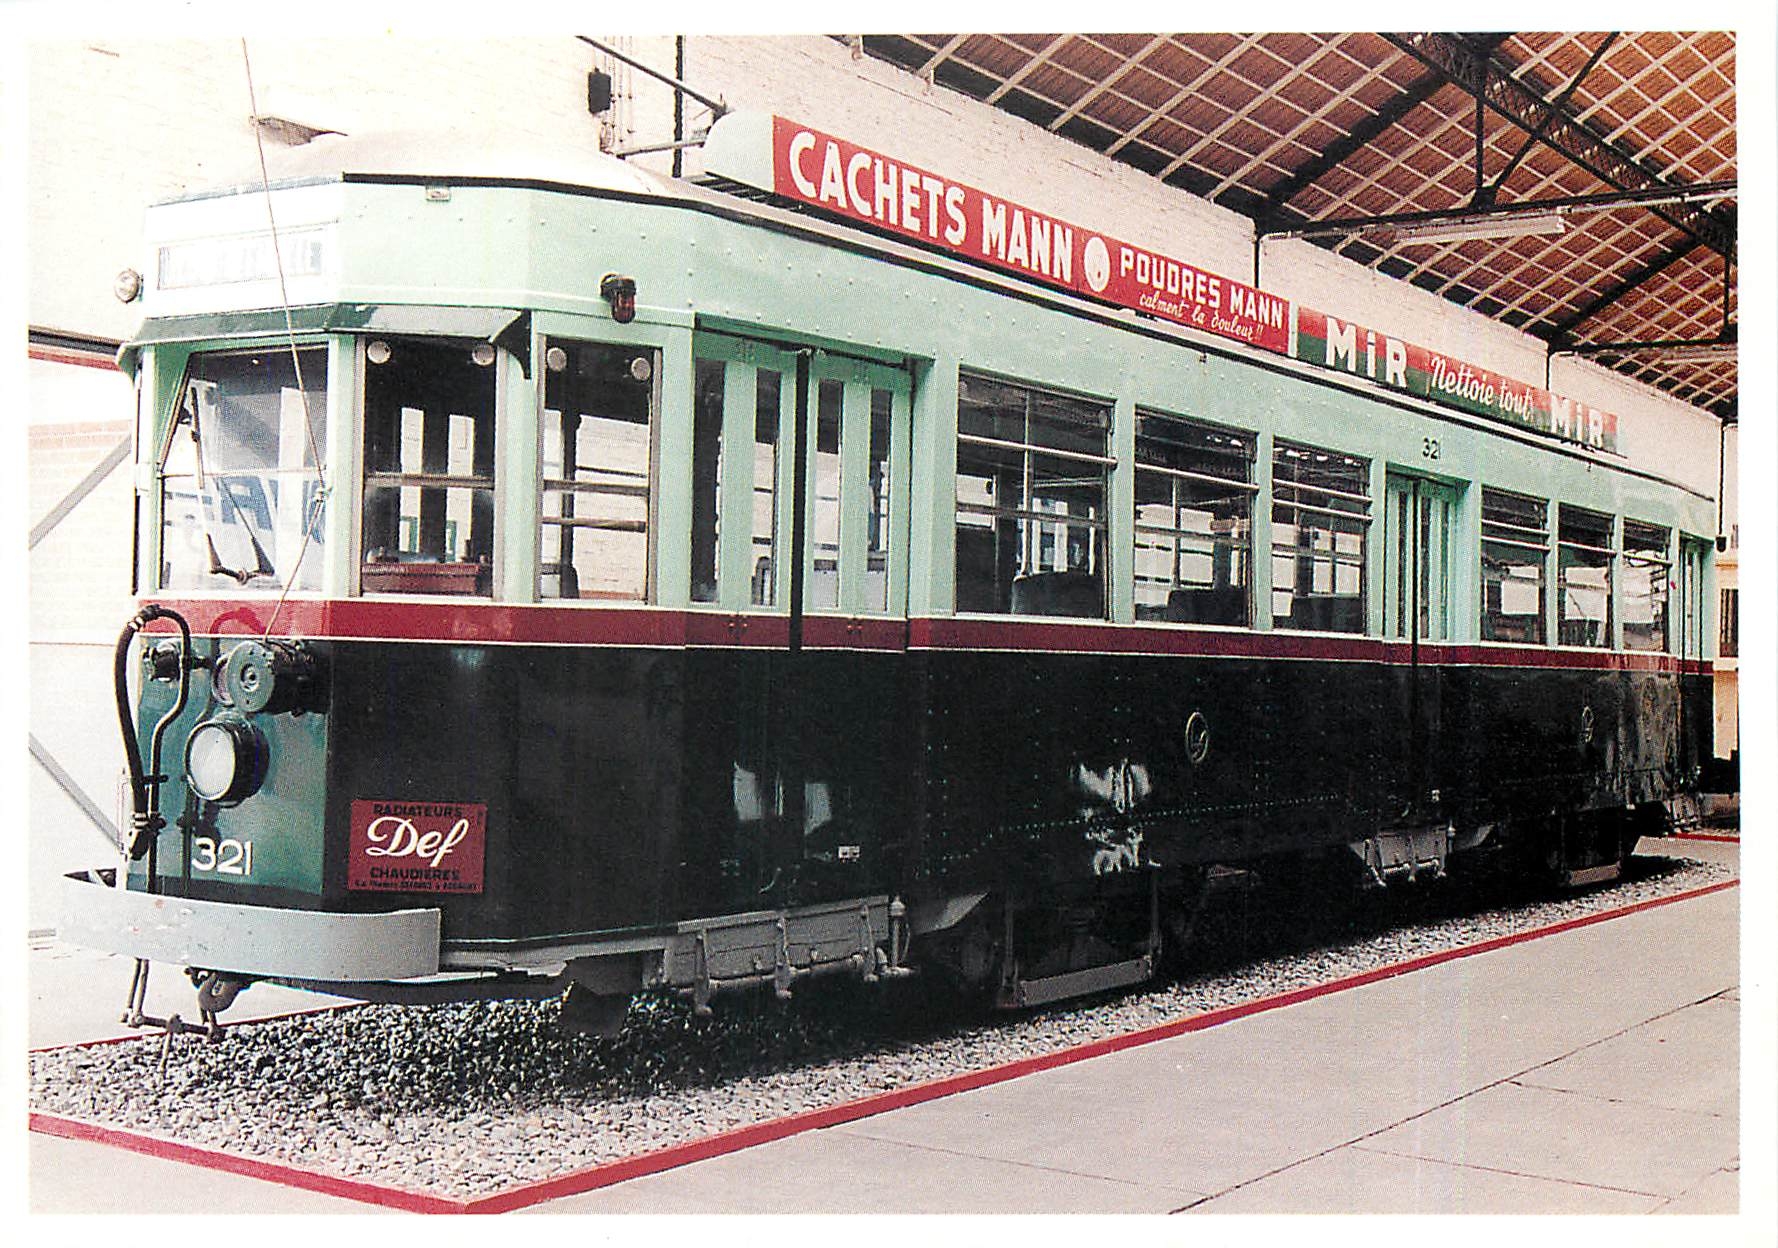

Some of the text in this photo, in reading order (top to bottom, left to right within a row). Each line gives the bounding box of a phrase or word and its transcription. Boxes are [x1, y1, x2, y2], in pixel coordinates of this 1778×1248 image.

[789, 132, 1073, 284] CACHETS MANN
[1120, 247, 1284, 330] POUDRES MANN
[1138, 291, 1190, 319] calment
[1191, 303, 1206, 326] la
[1431, 356, 1495, 407] Nettoie
[372, 803, 464, 818] RADIATEURS
[191, 837, 253, 876] 321
[365, 816, 470, 868] Def
